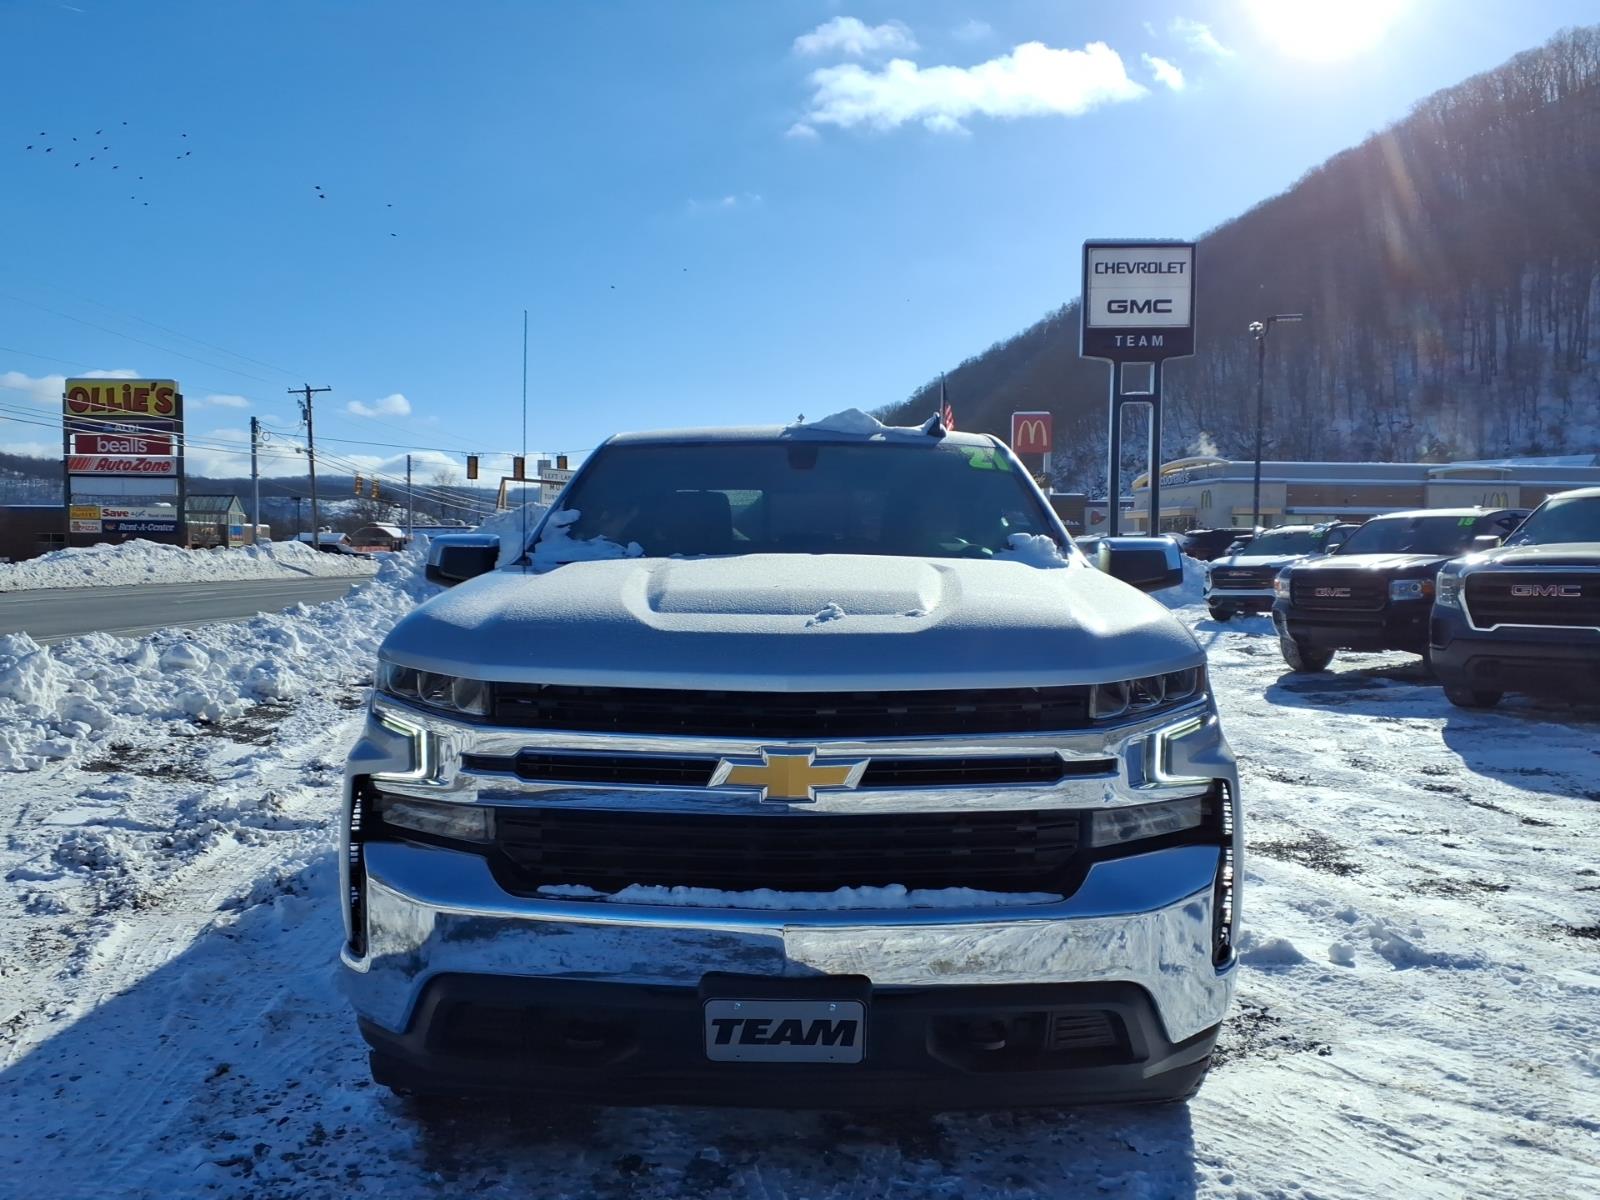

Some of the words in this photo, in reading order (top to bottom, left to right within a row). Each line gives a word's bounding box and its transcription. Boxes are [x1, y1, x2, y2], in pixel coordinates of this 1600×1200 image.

[1095, 262, 1186, 274] CHEVROLET
[1107, 299, 1172, 314] GMC
[1115, 335, 1164, 347] TEAM
[97, 437, 148, 453] bealls
[95, 457, 172, 471] AutoZone
[102, 508, 129, 518] Save
[118, 523, 175, 532] Rent-A-Center
[1315, 587, 1351, 597] GMC
[1511, 584, 1581, 597] GMC
[711, 1018, 858, 1047] TEAM
